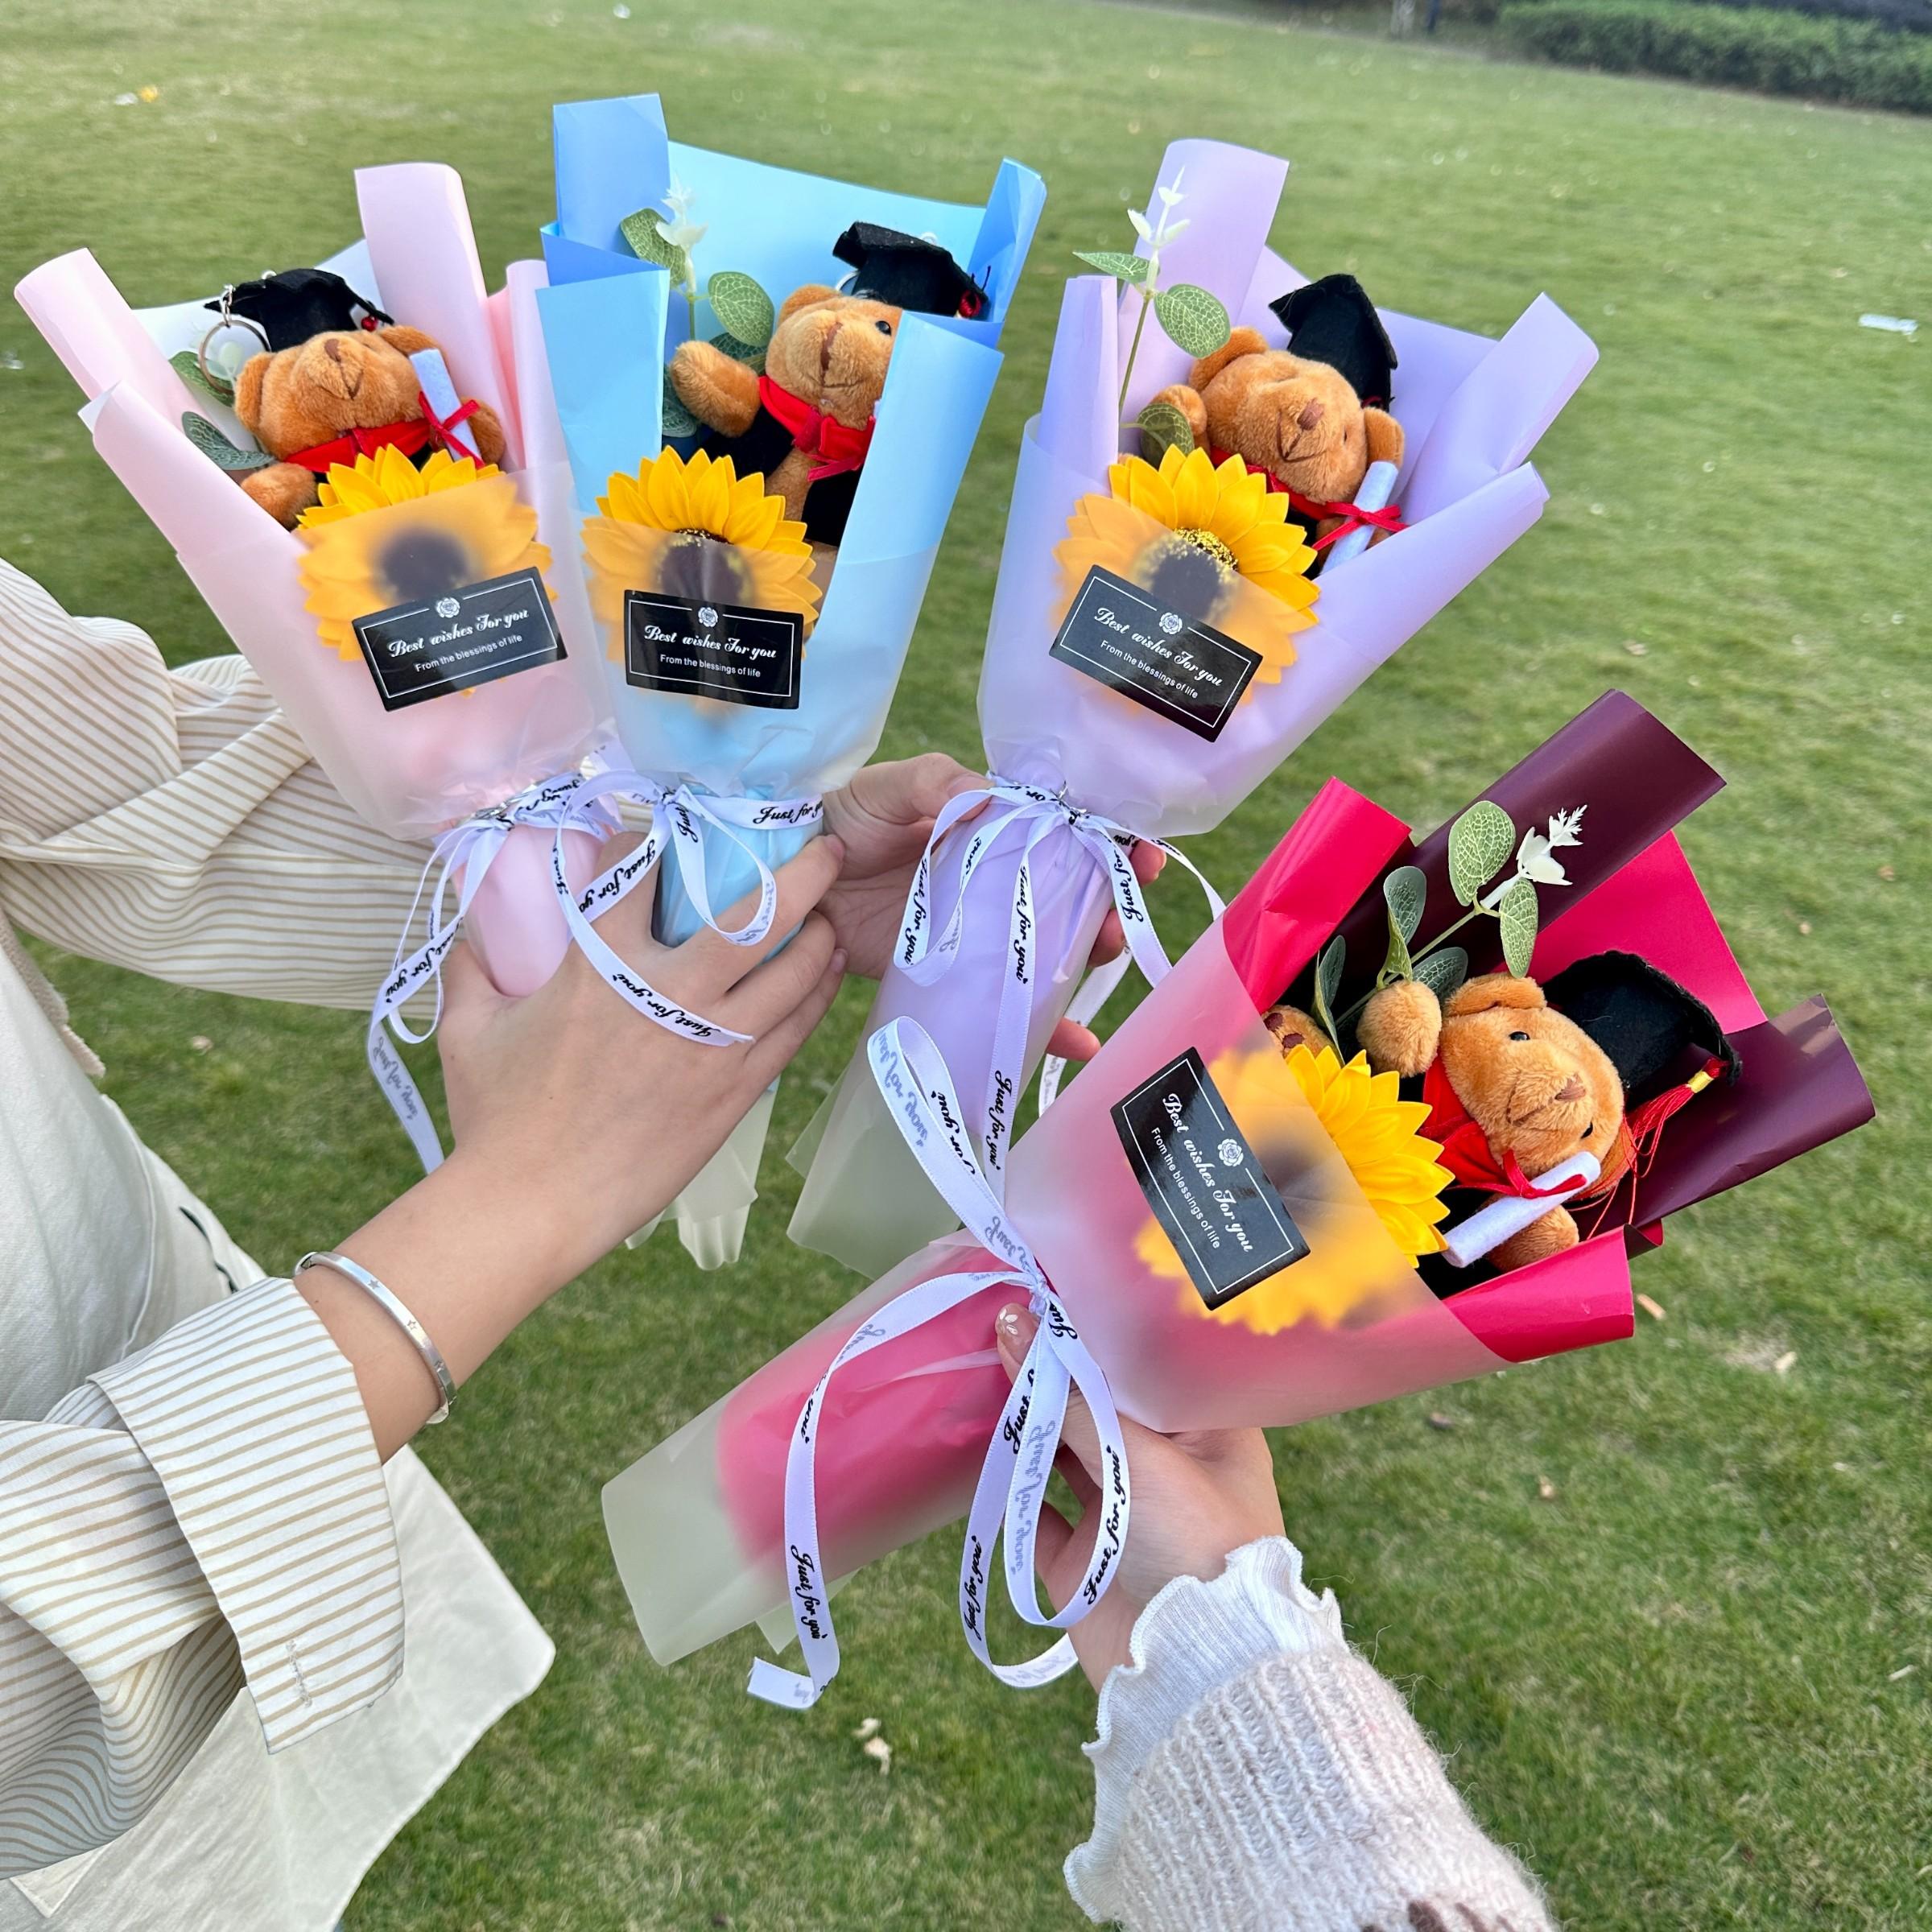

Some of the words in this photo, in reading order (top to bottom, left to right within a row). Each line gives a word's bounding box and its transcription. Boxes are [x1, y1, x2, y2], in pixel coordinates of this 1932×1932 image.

[387, 638, 424, 658] Best
[430, 623, 473, 645] wishes
[476, 613, 502, 631] For
[504, 609, 529, 628] you
[644, 625, 677, 643] Best
[682, 634, 721, 650] wishes
[724, 638, 749, 654] For
[749, 647, 777, 660] you
[1094, 607, 1130, 634] Best
[1131, 631, 1172, 658] wishes
[1174, 650, 1199, 673] For
[1195, 671, 1224, 687] you
[415, 660, 440, 672] From
[442, 654, 455, 664] the
[455, 642, 497, 660] blessings
[498, 638, 508, 647] of
[508, 634, 522, 645] life
[660, 654, 683, 665] From
[684, 658, 698, 667] the
[700, 660, 736, 675] blessings
[738, 667, 747, 675] of
[747, 668, 761, 677] life
[1100, 640, 1123, 658] From
[1124, 652, 1137, 666] the
[1137, 659, 1175, 687] blessings
[1175, 683, 1187, 693] of
[1184, 683, 1199, 699] life
[753, 807, 795, 824] Just
[790, 803, 813, 824] for
[624, 839, 656, 880] Just
[1113, 849, 1133, 882] for
[598, 868, 624, 898] for
[918, 858, 929, 899] Just
[1017, 865, 1029, 908] Just
[579, 889, 595, 913] yo
[914, 892, 927, 931] for
[1120, 881, 1144, 923] Just
[1016, 901, 1031, 941] for
[412, 947, 436, 977] for
[904, 927, 918, 964] you
[1013, 939, 1026, 981] you
[385, 968, 407, 998] you
[617, 973, 653, 997] you
[647, 1001, 685, 1018] for
[675, 1017, 721, 1037] Just
[995, 1070, 1012, 1116] Just
[938, 1092, 960, 1133] you
[985, 1108, 1005, 1139] for
[1162, 1093, 1189, 1133] Best
[986, 1136, 998, 1165] you
[1151, 1128, 1167, 1154] From
[1165, 1154, 1176, 1171] the
[1183, 1139, 1216, 1187] wishes
[1172, 1170, 1203, 1221] blessings
[1213, 1189, 1236, 1220] For
[1200, 1220, 1211, 1232] of
[1205, 1226, 1220, 1249] life
[1224, 1222, 1253, 1252] you
[1084, 1546, 1112, 1604] Just
[1106, 1502, 1119, 1556] for
[1114, 1451, 1125, 1505] you
[791, 1545, 815, 1591] Just
[972, 1541, 984, 1583] you
[795, 1587, 820, 1616] for
[964, 1577, 980, 1612] for
[801, 1616, 821, 1640] you
[964, 1601, 982, 1641] Just
